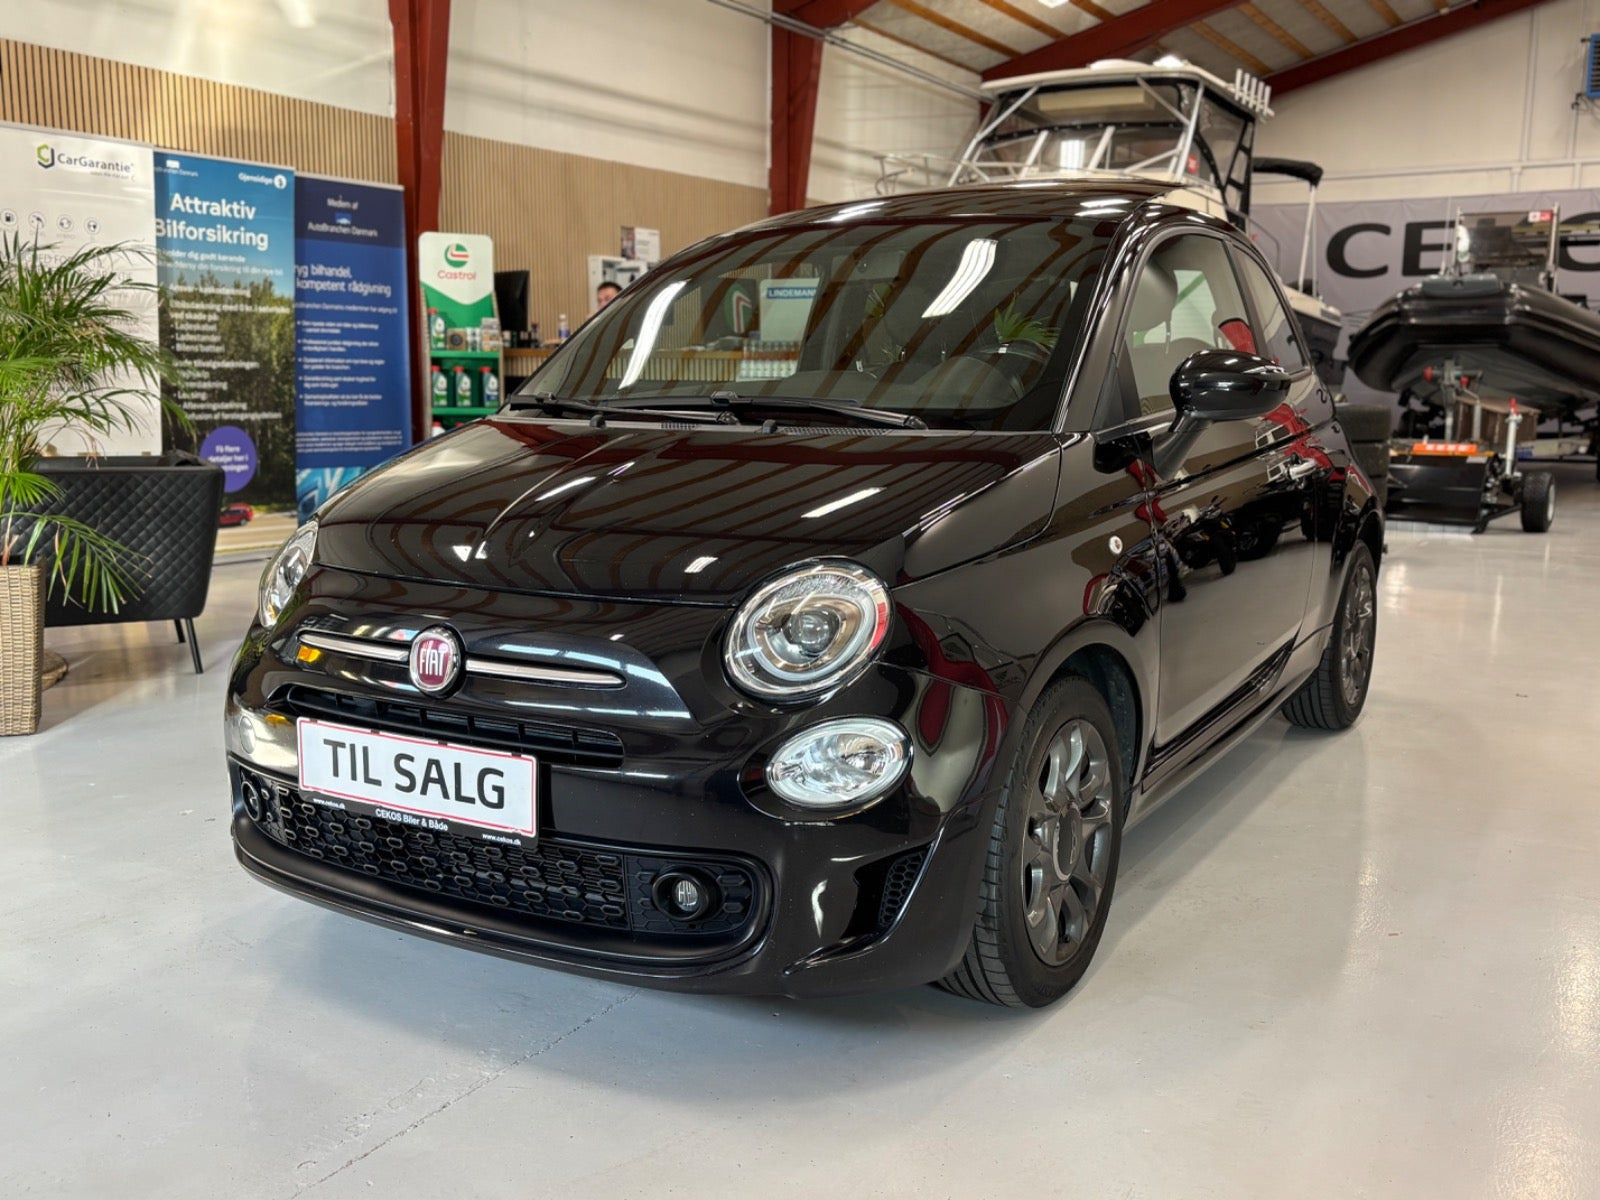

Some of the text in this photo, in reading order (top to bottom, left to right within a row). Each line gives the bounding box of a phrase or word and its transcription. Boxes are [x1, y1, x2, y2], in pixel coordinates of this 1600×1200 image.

[57, 153, 131, 172] CarGarantie
[170, 193, 256, 219] Attraktiv
[155, 218, 268, 251] Bilforsikring
[293, 265, 308, 278] ryg
[437, 270, 476, 280] Castrol
[348, 281, 391, 297] rådgivning
[420, 640, 447, 676] FIAT
[323, 738, 505, 810] TIL SALG
[375, 808, 448, 831] CEKOS Biler & Både
